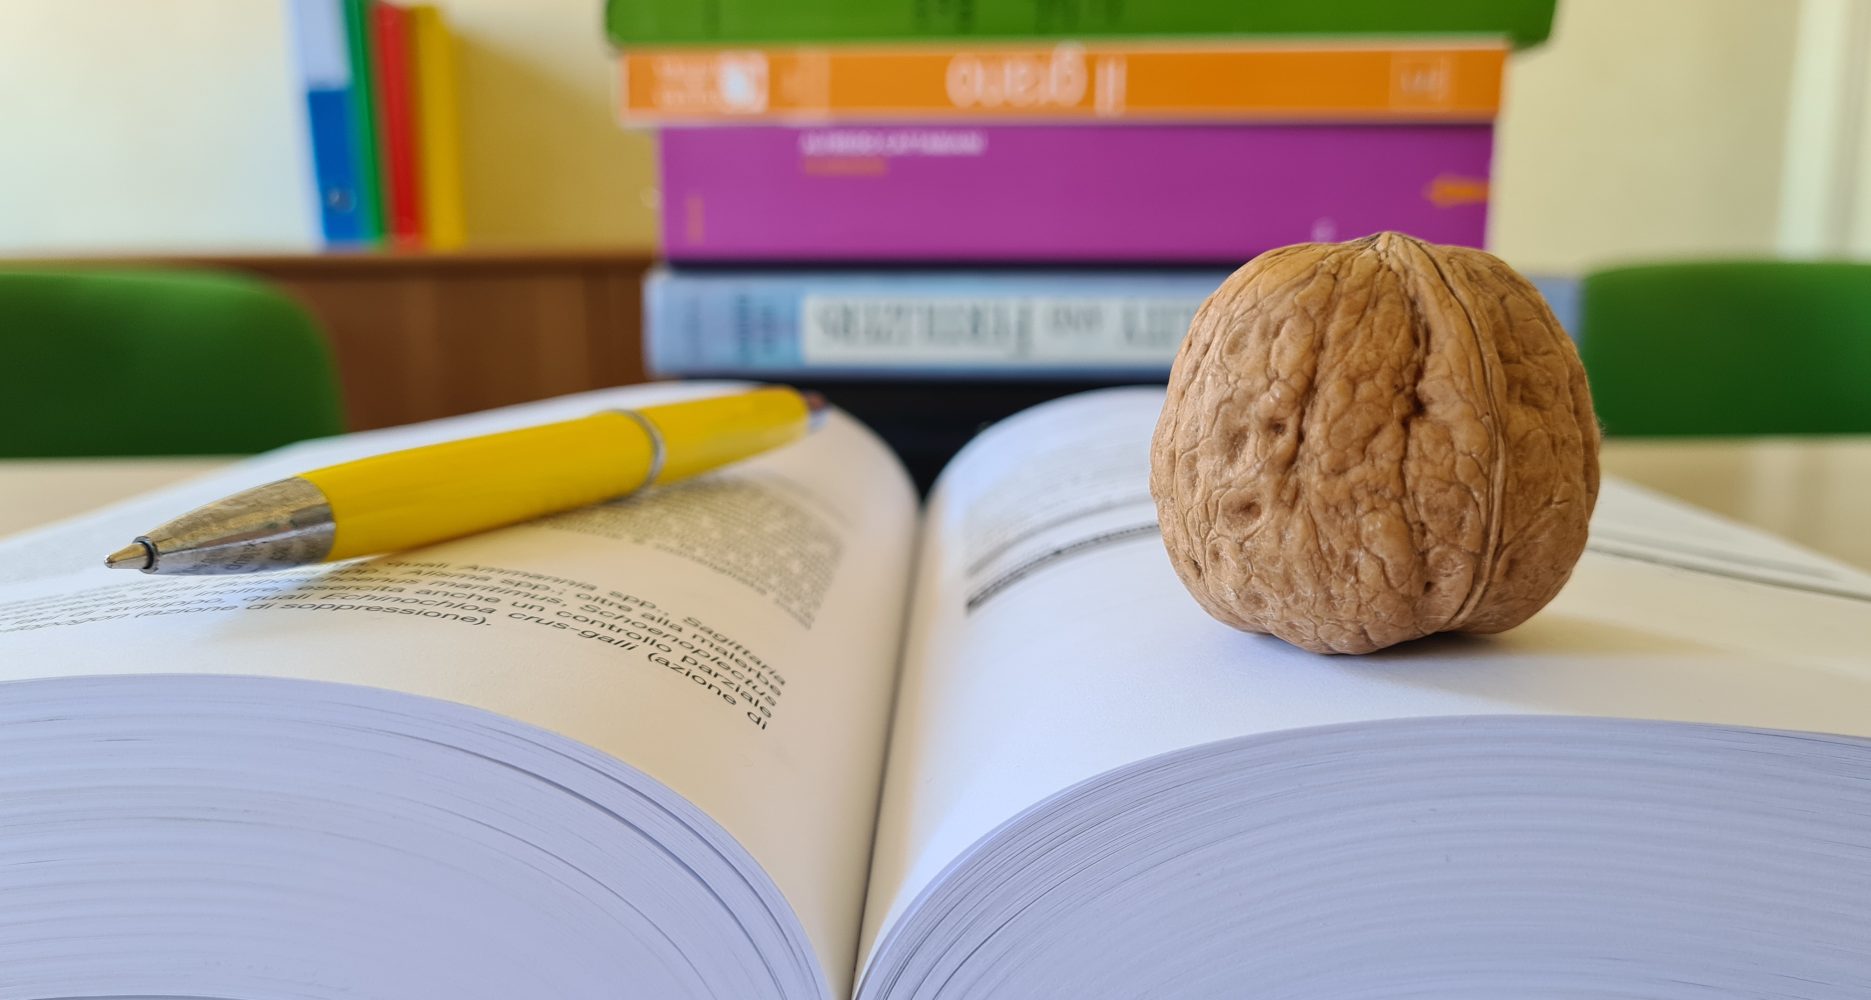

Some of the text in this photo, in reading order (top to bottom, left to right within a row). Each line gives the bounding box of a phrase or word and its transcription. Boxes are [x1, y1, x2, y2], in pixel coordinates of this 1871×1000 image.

[945, 41, 1087, 108] grano
[241, 592, 314, 602] quali
[320, 592, 498, 614] Echinochloa
[507, 612, 640, 651] crus-galli
[647, 652, 737, 706] (azione
[746, 711, 768, 730] di
[244, 601, 278, 610] di
[279, 602, 492, 626] soppressione).
[296, 584, 405, 594] esercita
[414, 588, 501, 603] anche
[511, 600, 545, 612] un
[556, 610, 673, 653] controllo
[681, 655, 772, 719] parziale
[575, 592, 634, 613] oltre
[692, 633, 782, 697] malerbe
[579, 603, 777, 707] Schoenoplectus
[682, 616, 786, 686] Sagittaria
